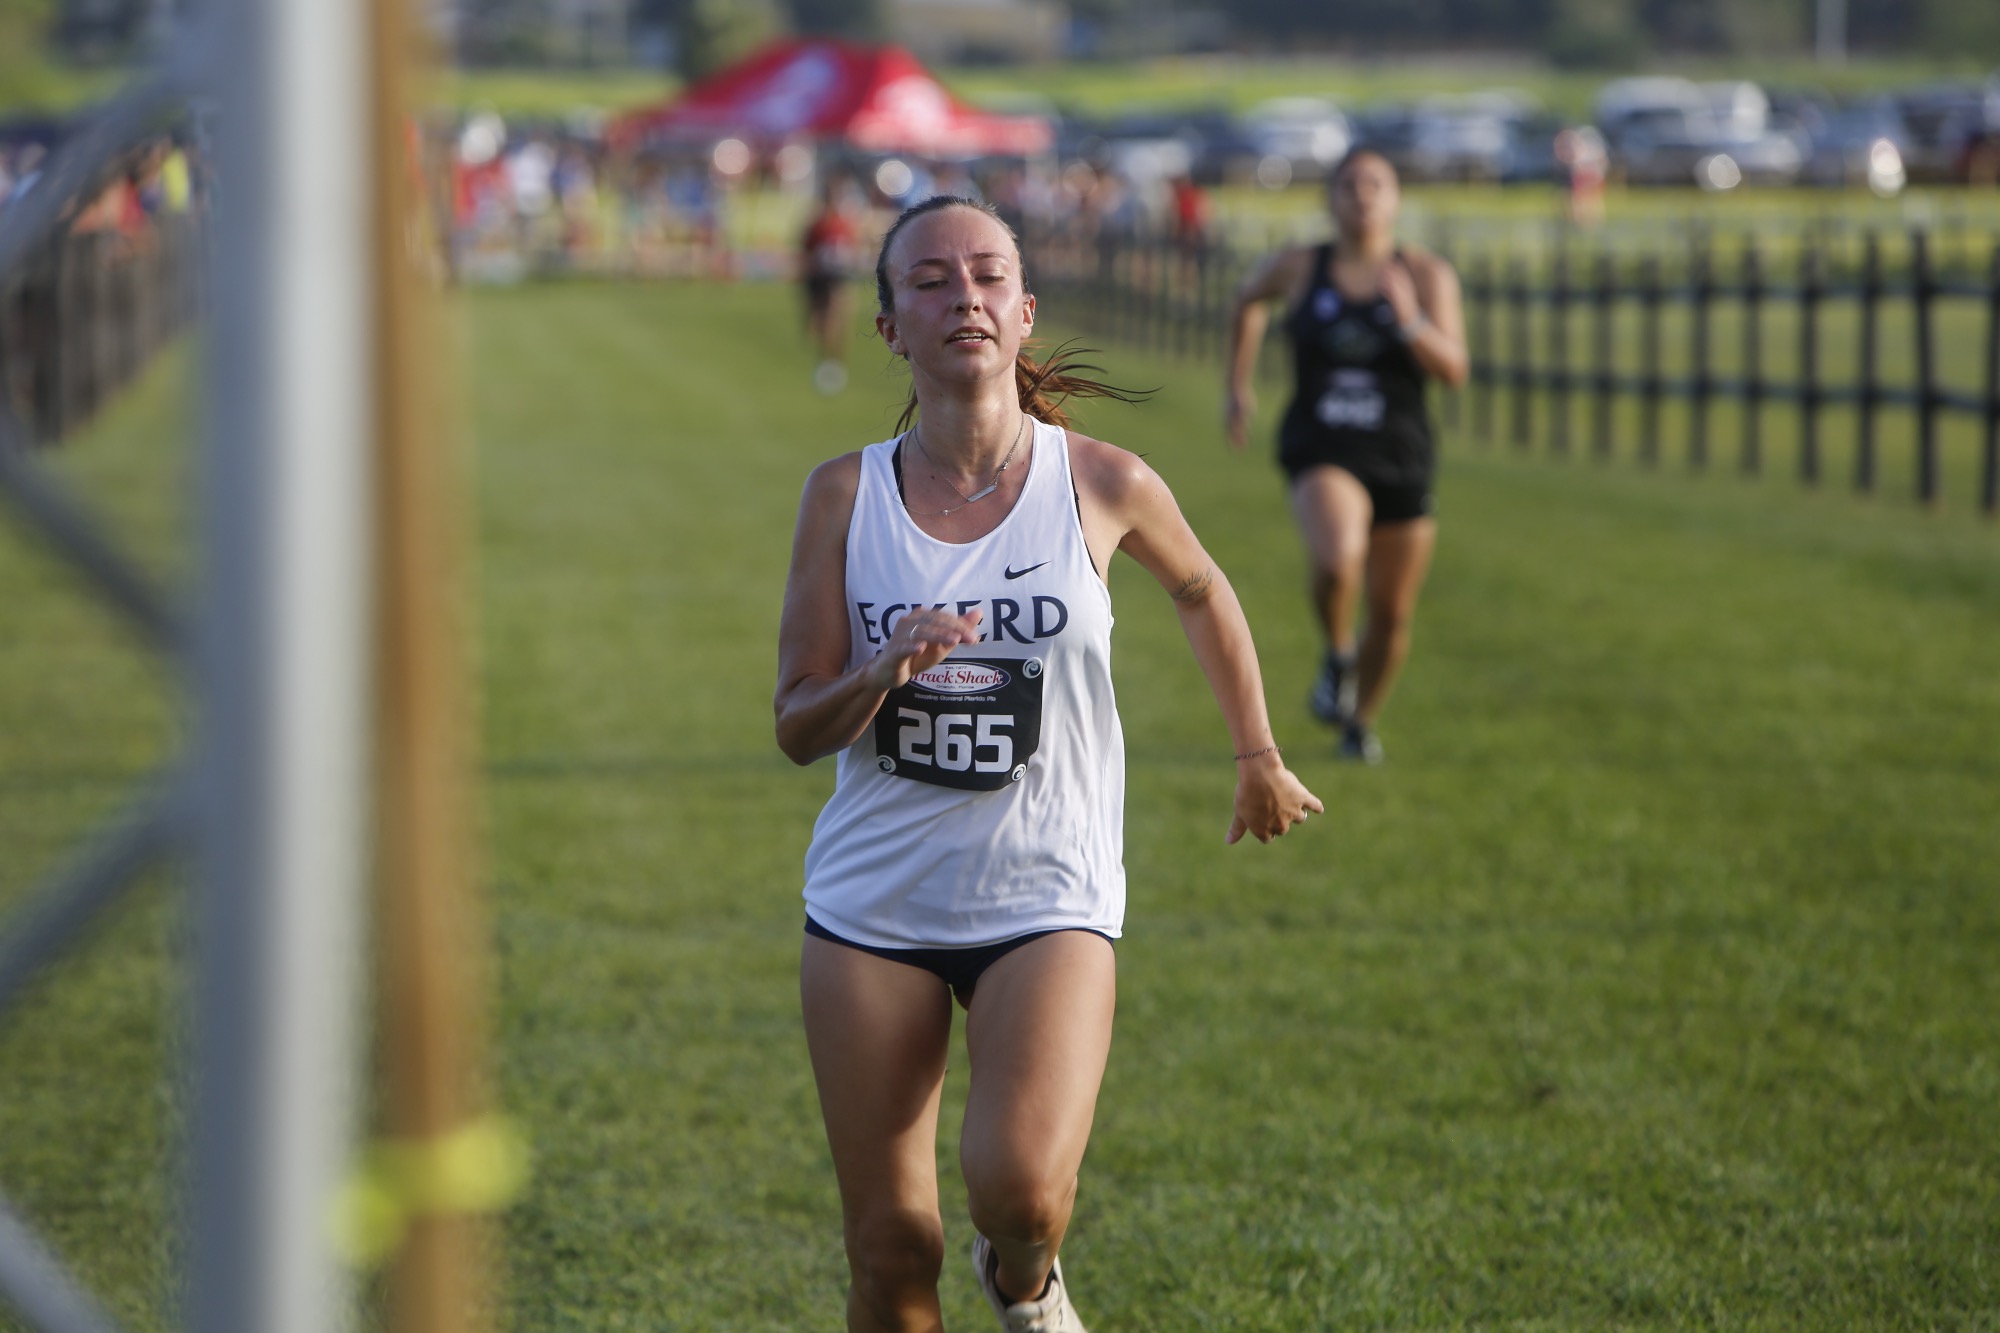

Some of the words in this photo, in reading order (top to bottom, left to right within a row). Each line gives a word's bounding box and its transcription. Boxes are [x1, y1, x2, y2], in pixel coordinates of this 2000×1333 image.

[857, 596, 1068, 644] ECERD
[955, 670, 1003, 685] Shack
[898, 708, 1014, 772] 265
